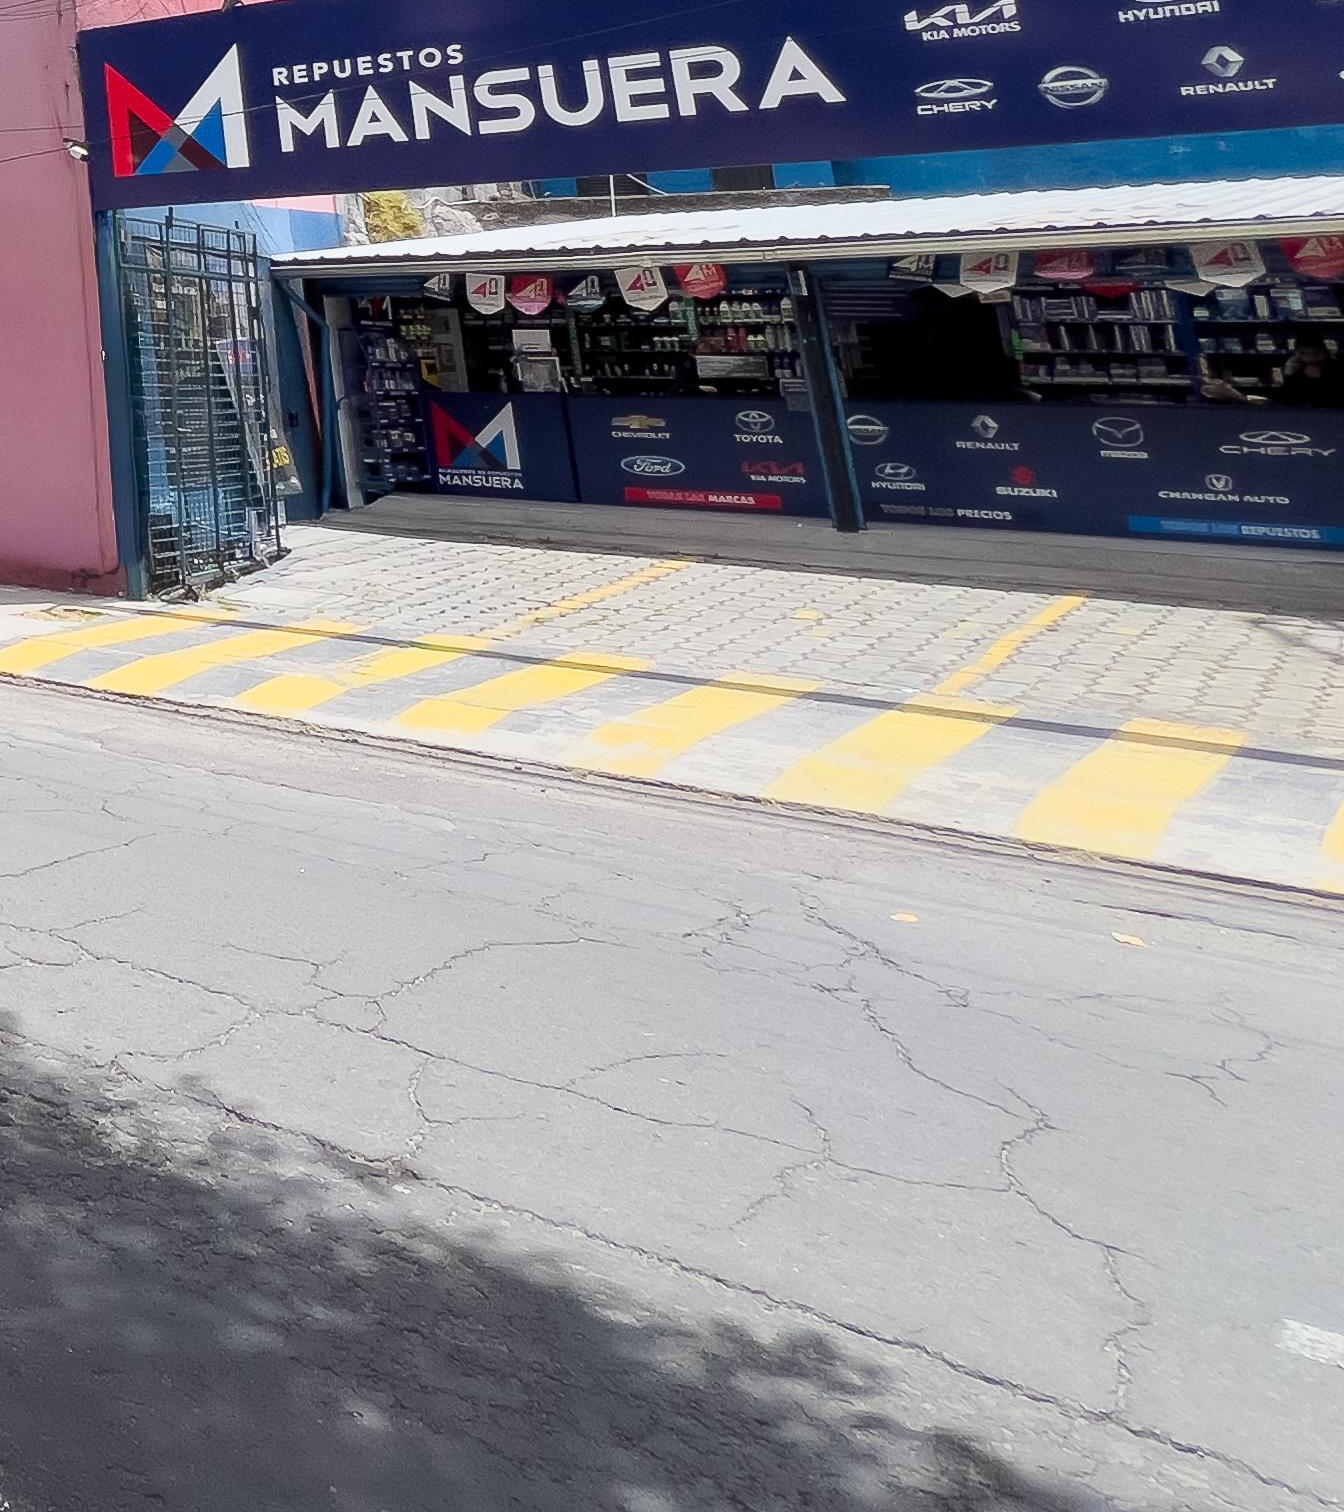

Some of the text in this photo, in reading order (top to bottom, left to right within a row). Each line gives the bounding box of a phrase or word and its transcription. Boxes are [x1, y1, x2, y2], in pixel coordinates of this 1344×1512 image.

[1118, 0, 1221, 23] HYUNDAI
[921, 21, 1022, 42] KIA MOTORS
[272, 43, 464, 87] REPUESTOS
[275, 35, 847, 153] MANSUERA
[1180, 78, 1278, 96] RENAULT
[916, 98, 998, 116] CHERY
[734, 433, 784, 444] TOYOTA
[955, 441, 1020, 451] RENAULT
[1218, 445, 1338, 457] CHERY
[633, 458, 673, 473] Ford
[438, 473, 524, 490] MANSUERA
[708, 494, 756, 505] MARCAS
[995, 486, 1058, 498] SUZUKI
[1158, 490, 1290, 505] CHANGAN AUTO
[956, 508, 1013, 521] PRECIOS
